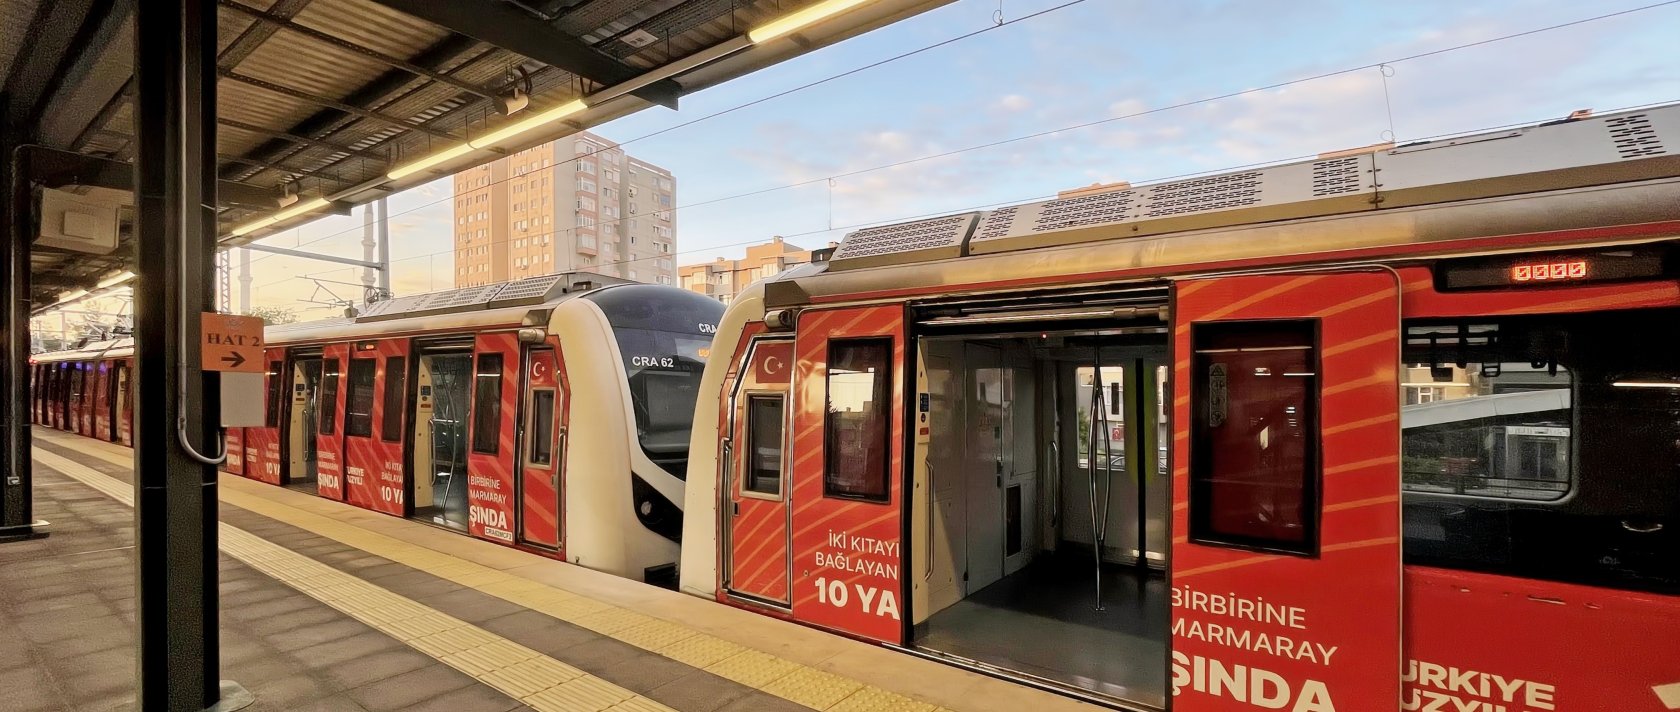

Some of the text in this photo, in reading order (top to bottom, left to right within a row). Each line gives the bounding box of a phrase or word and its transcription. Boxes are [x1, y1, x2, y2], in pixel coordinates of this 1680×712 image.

[207, 333, 260, 347] HAT 2
[698, 323, 717, 334] CRA
[632, 356, 674, 368] CRA 62
[382, 486, 391, 502] 10
[469, 489, 506, 505] MARMARAY
[469, 505, 507, 529] ŞINDA
[828, 529, 900, 558] İKİ KITAYI
[815, 551, 898, 581] BAĞLAYAN
[815, 577, 900, 620] 10 YA
[1171, 584, 1306, 629] BİRBİRİNE
[1171, 617, 1338, 666] MARMARAY
[1172, 650, 1336, 712] ŞINDA
